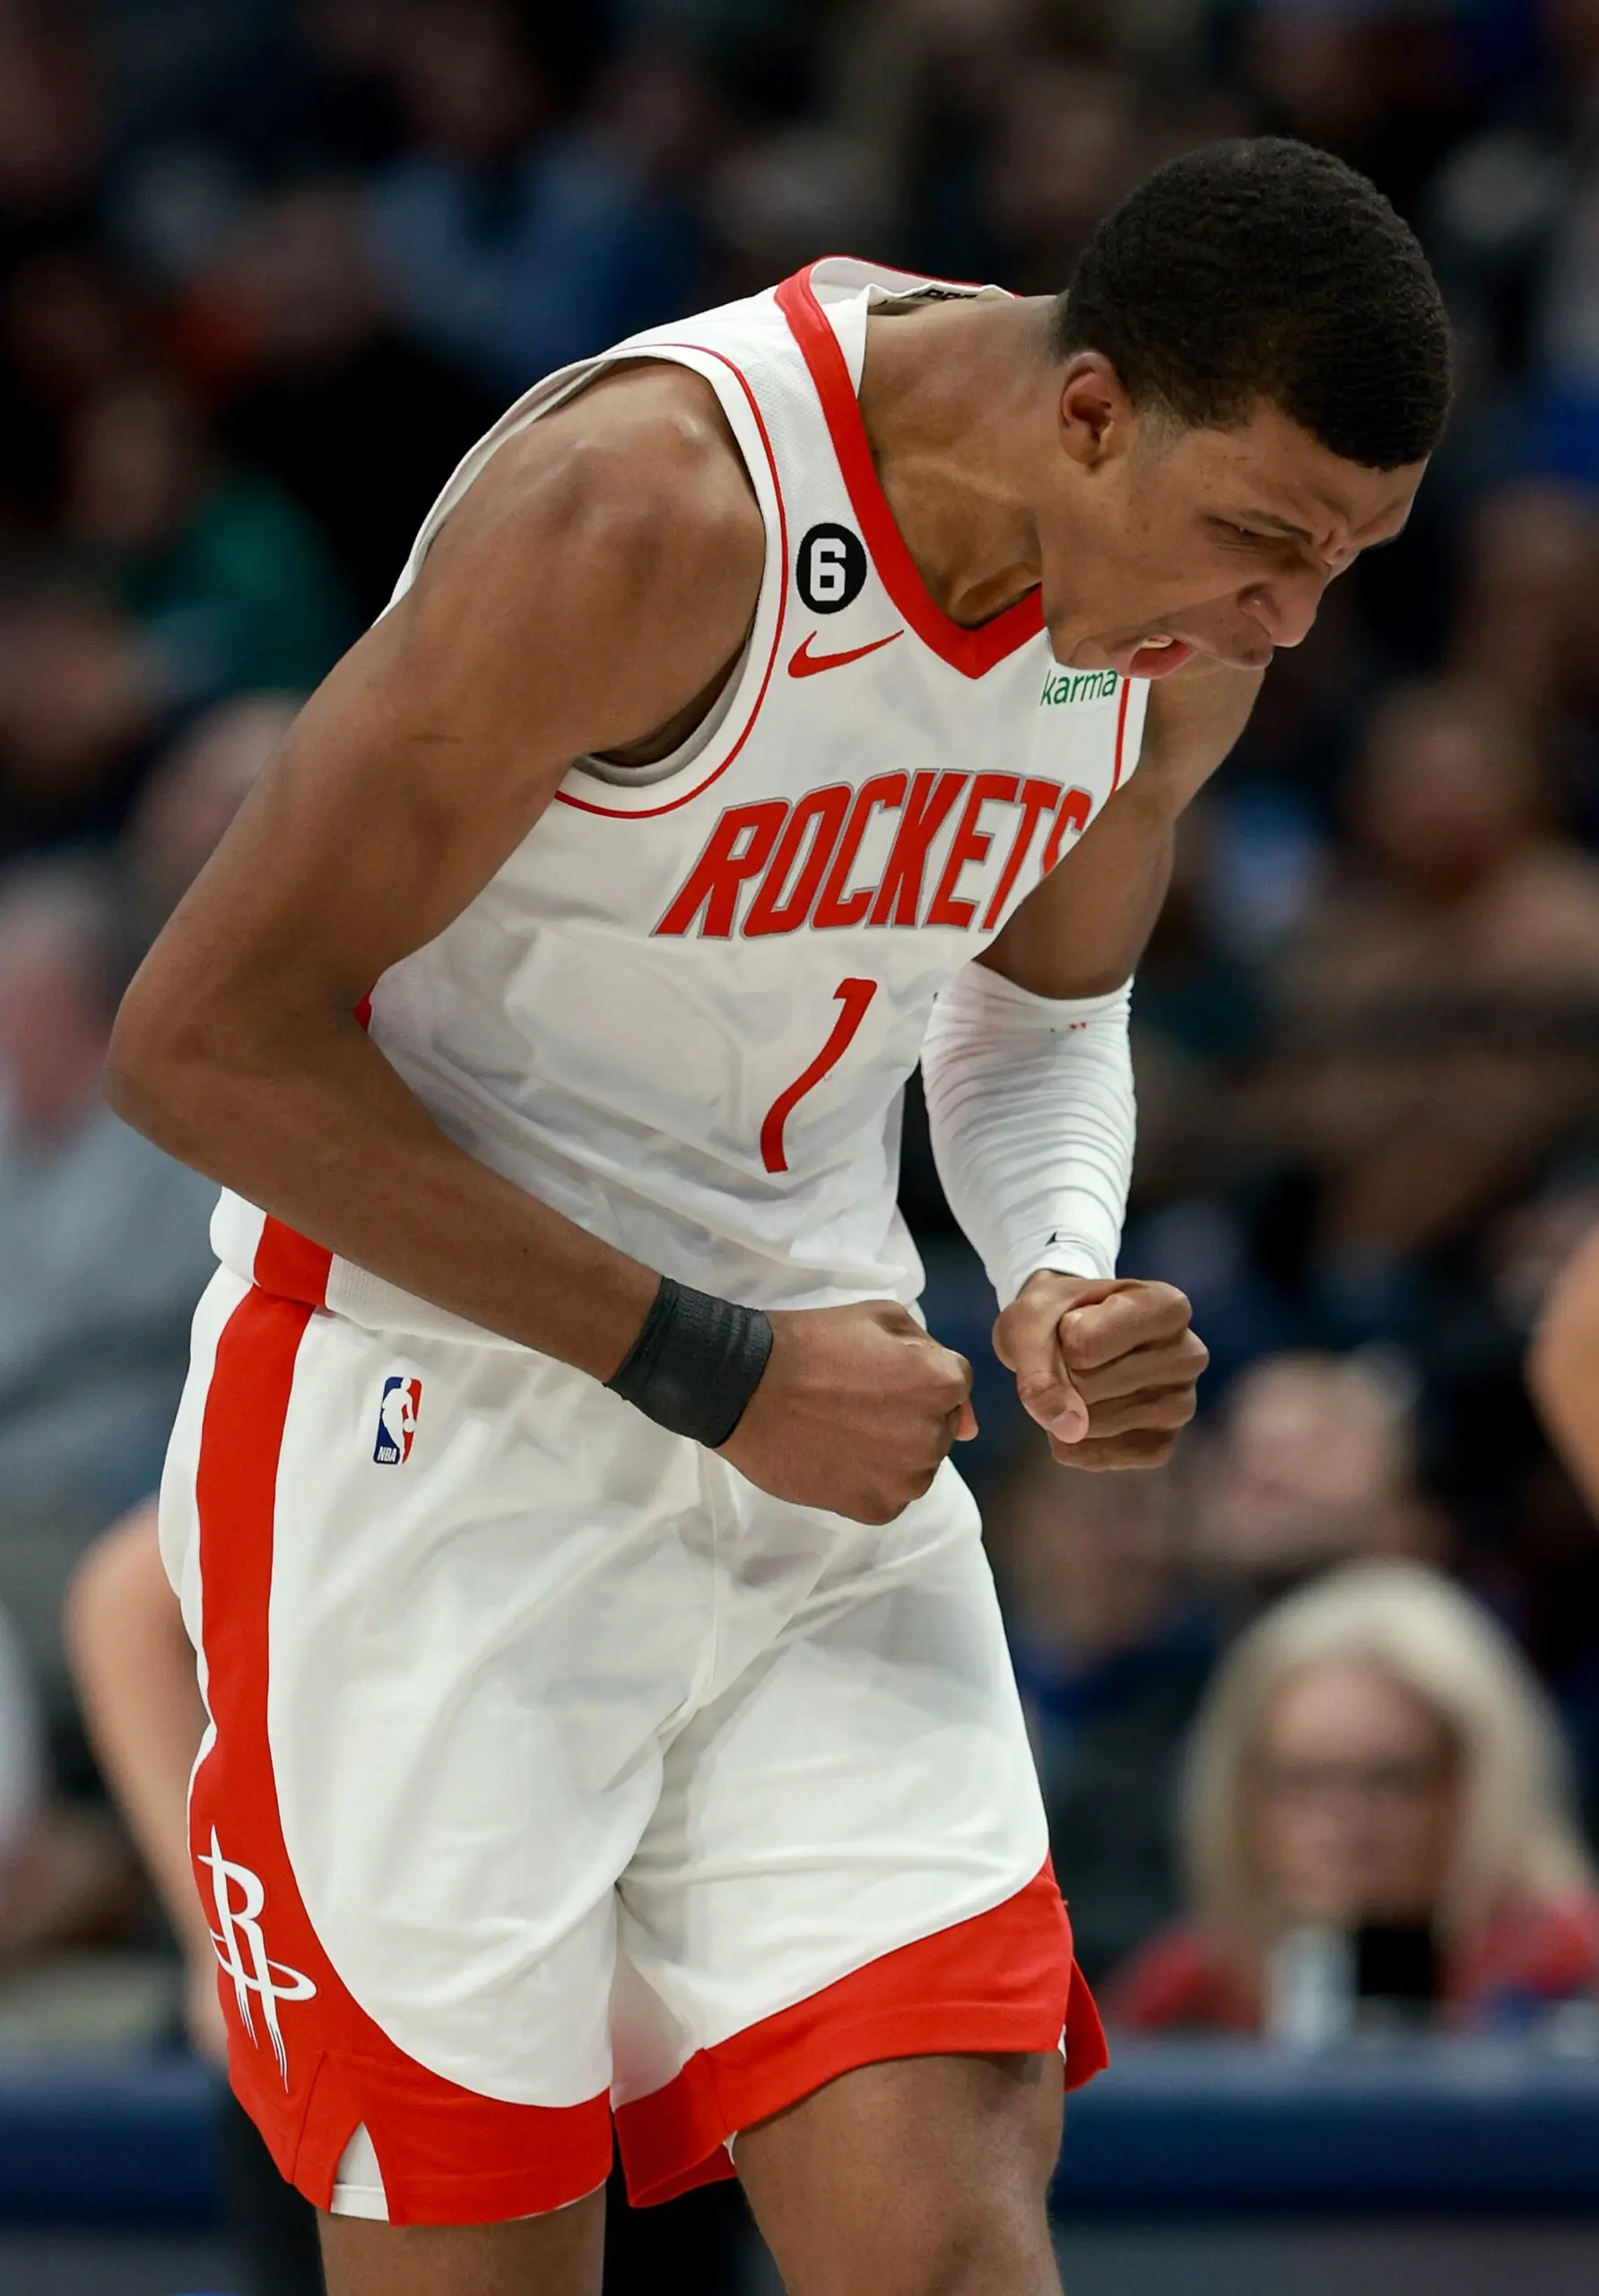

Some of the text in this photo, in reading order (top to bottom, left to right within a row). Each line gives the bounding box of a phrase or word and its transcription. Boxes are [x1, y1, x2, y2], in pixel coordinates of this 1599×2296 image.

[809, 537, 847, 601] 6
[1039, 669, 1118, 707] karma
[760, 977, 877, 1173] 1
[377, 1445, 397, 1462] NBA
